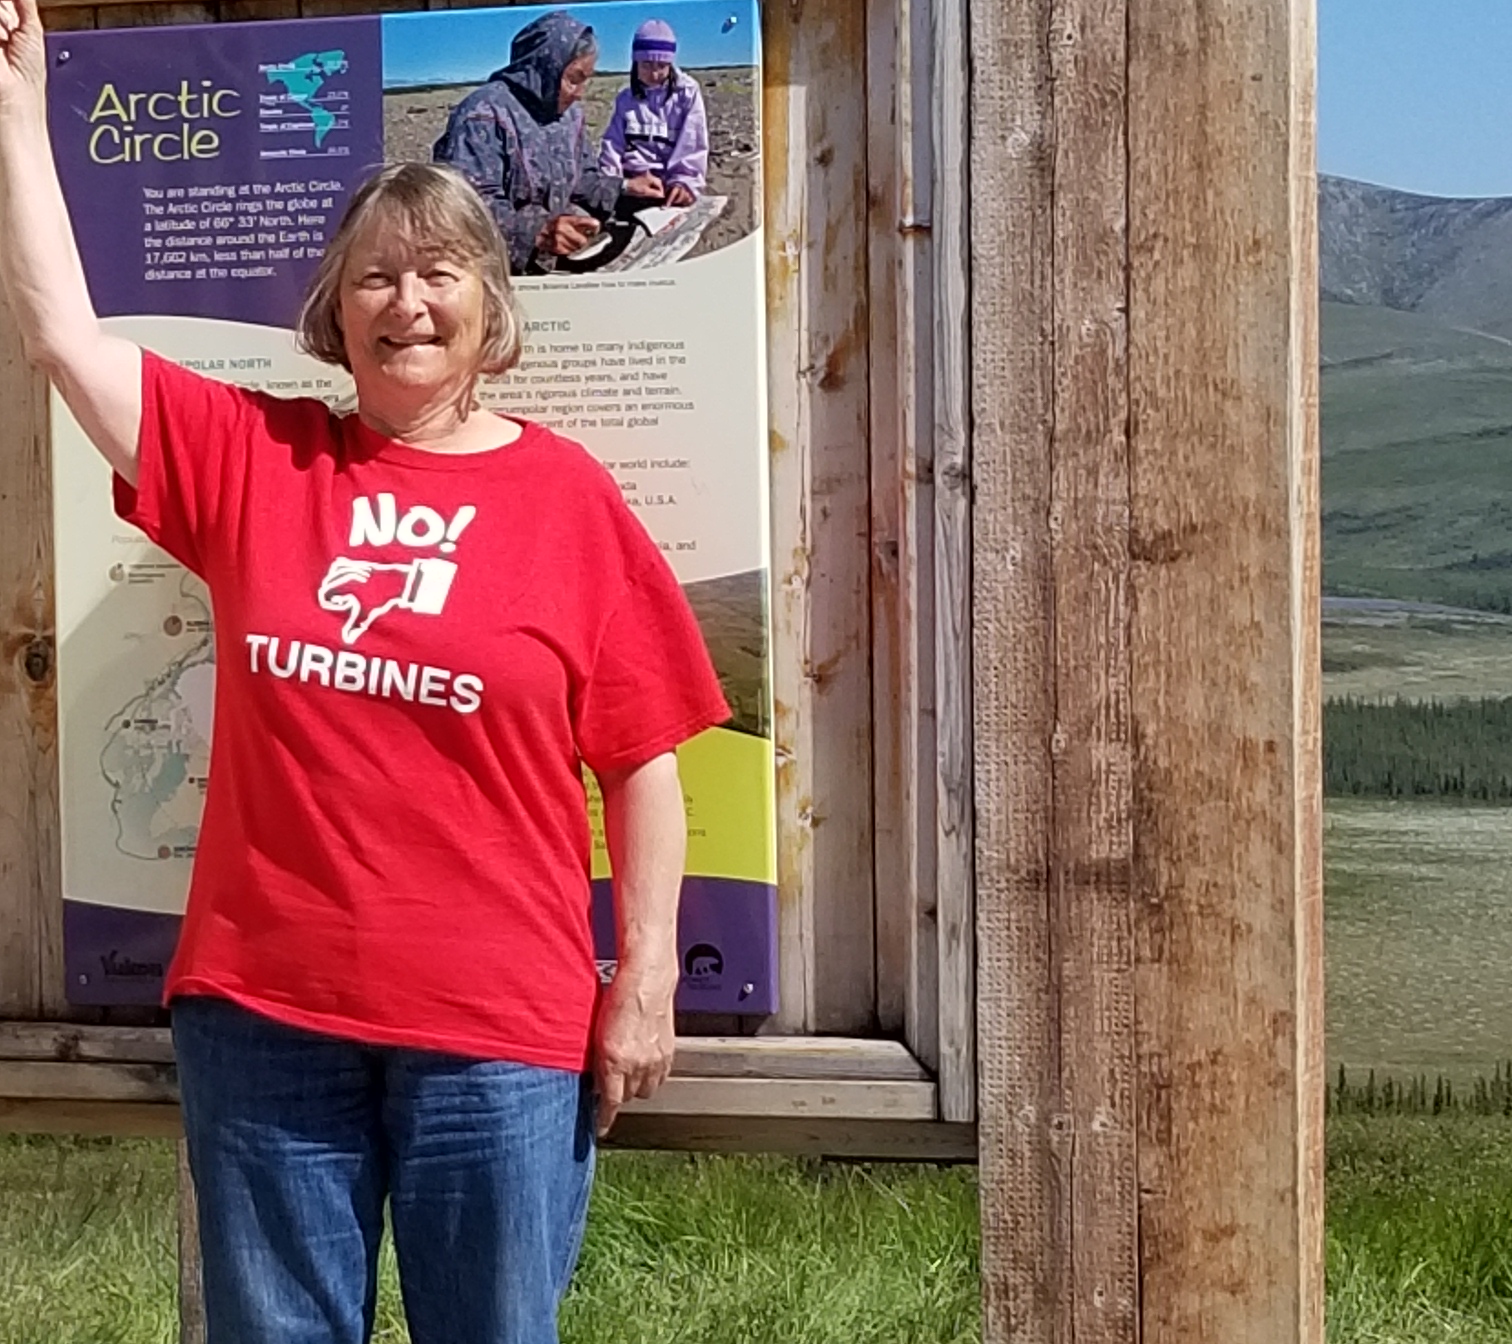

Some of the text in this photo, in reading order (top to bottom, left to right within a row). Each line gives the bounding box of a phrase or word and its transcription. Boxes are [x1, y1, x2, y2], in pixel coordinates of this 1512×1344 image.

[89, 80, 242, 123] Arctic
[89, 123, 220, 164] Circle
[143, 180, 344, 199] You are standing at the Arctic Circle.
[144, 197, 333, 215] The Arctic Circle rings the globe at
[144, 223, 151, 231] a
[155, 219, 196, 231] latitude
[199, 217, 211, 229] of
[298, 214, 325, 225] Here
[144, 230, 324, 248] the distance around the Earth is
[214, 251, 237, 261] less
[240, 249, 265, 260] than
[269, 248, 290, 259] half
[293, 247, 305, 258] of
[307, 247, 326, 258] the
[145, 269, 192, 280] distance
[195, 268, 208, 279] at
[210, 267, 228, 278] the
[523, 320, 571, 332] ARCTIC
[549, 343, 579, 353] home
[582, 342, 593, 353] to
[627, 340, 685, 352] indigenous
[229, 358, 271, 369] NORTH
[561, 358, 597, 370] groups
[601, 356, 625, 367] have
[629, 355, 653, 366] lived
[656, 355, 666, 365] in
[669, 354, 686, 364] the
[530, 372, 581, 384] countless
[619, 371, 639, 381] and
[642, 370, 667, 381] have
[535, 388, 577, 401] rigorous
[580, 387, 618, 397] climate
[622, 386, 642, 396] and
[552, 403, 584, 416] region
[587, 402, 621, 413] covers
[625, 402, 638, 412] an
[641, 400, 695, 411] enormous
[567, 418, 578, 428] of
[580, 417, 597, 427] the
[627, 415, 658, 428] global
[619, 459, 647, 468] world
[676, 540, 696, 550] and
[246, 633, 484, 713] TURBINES
